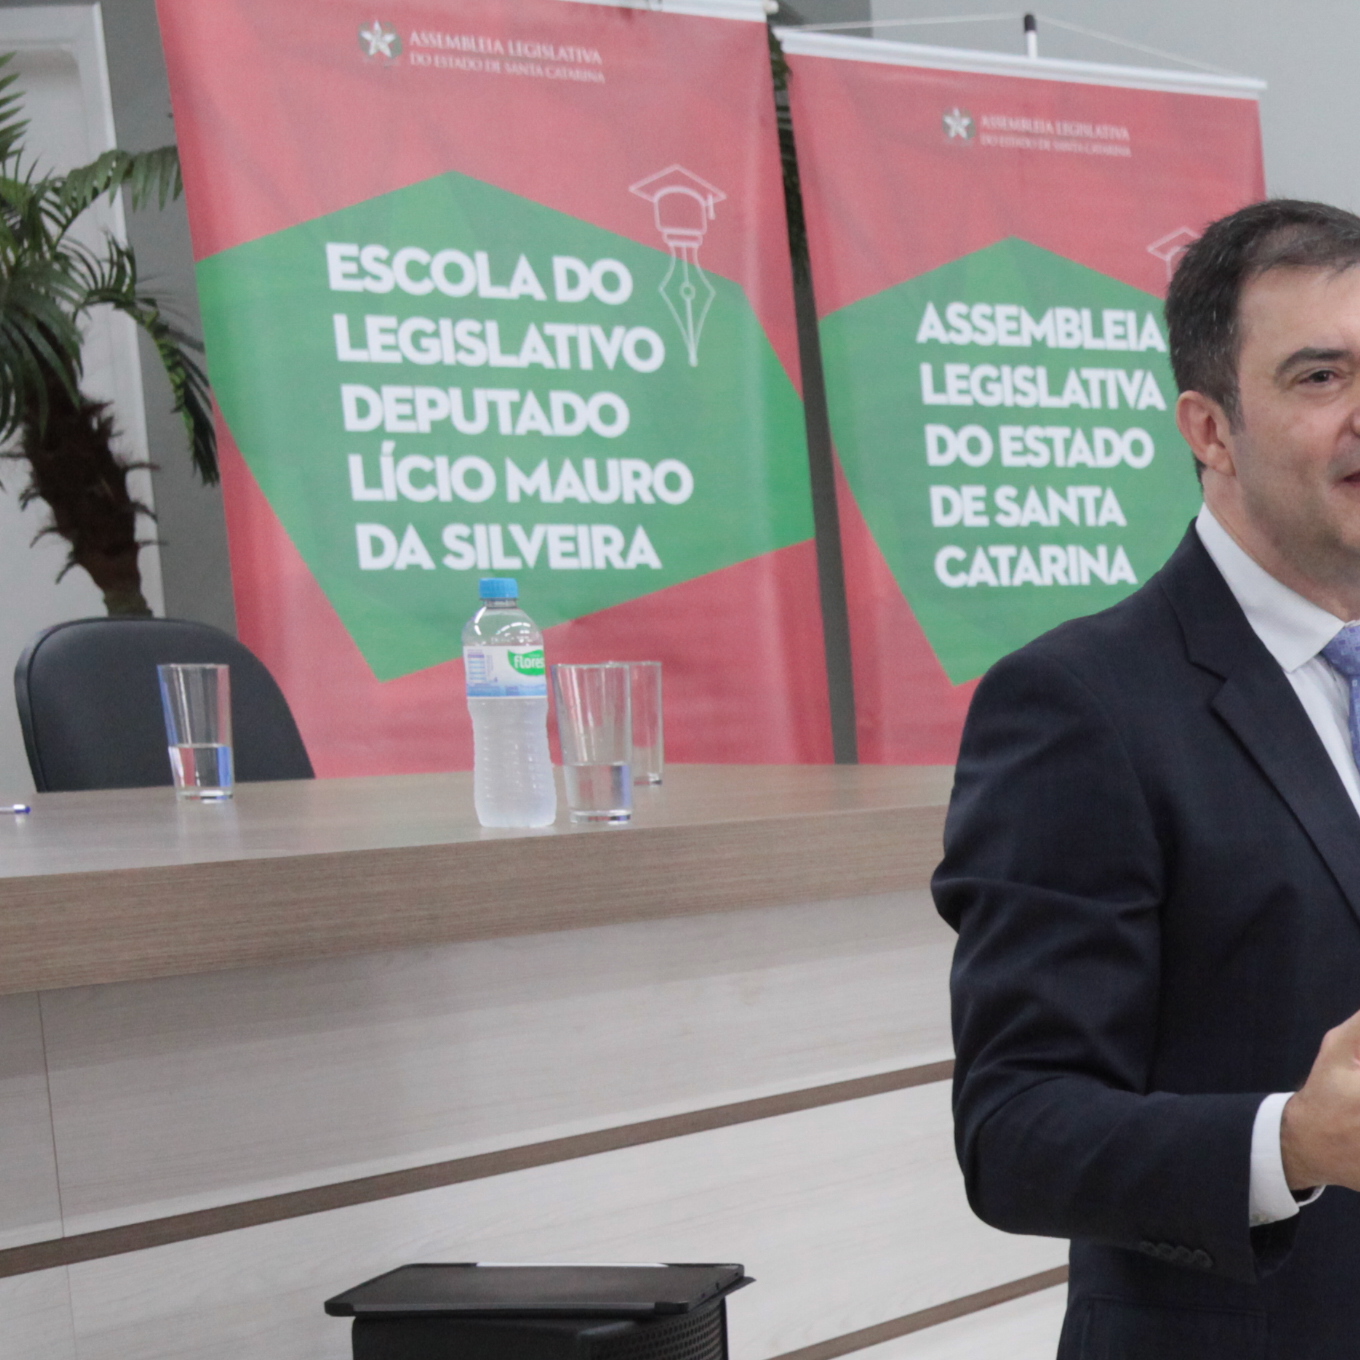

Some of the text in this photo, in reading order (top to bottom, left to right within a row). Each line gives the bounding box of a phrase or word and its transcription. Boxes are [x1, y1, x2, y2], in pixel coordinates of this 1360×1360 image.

[409, 30, 603, 65] ASSEMBLEIA LEGISLATIVA
[409, 52, 432, 66] DO
[434, 55, 483, 71] ESTADO
[485, 59, 501, 73] DE
[505, 61, 543, 77] SANTA
[326, 242, 633, 305] ESCOLA DO
[333, 313, 666, 373] LEGISLATIVO
[916, 302, 1167, 353] ASSEMBLEIA
[920, 362, 1167, 411] LEGISLATIVA
[340, 384, 630, 438] DEPUTADO
[925, 424, 1154, 469] DO ESTADO
[348, 440, 694, 505] LÍCIO MAURO
[929, 485, 1127, 527] DE SANTA
[355, 523, 663, 570] DA SILVEIRA
[934, 544, 1138, 588] CATARINA
